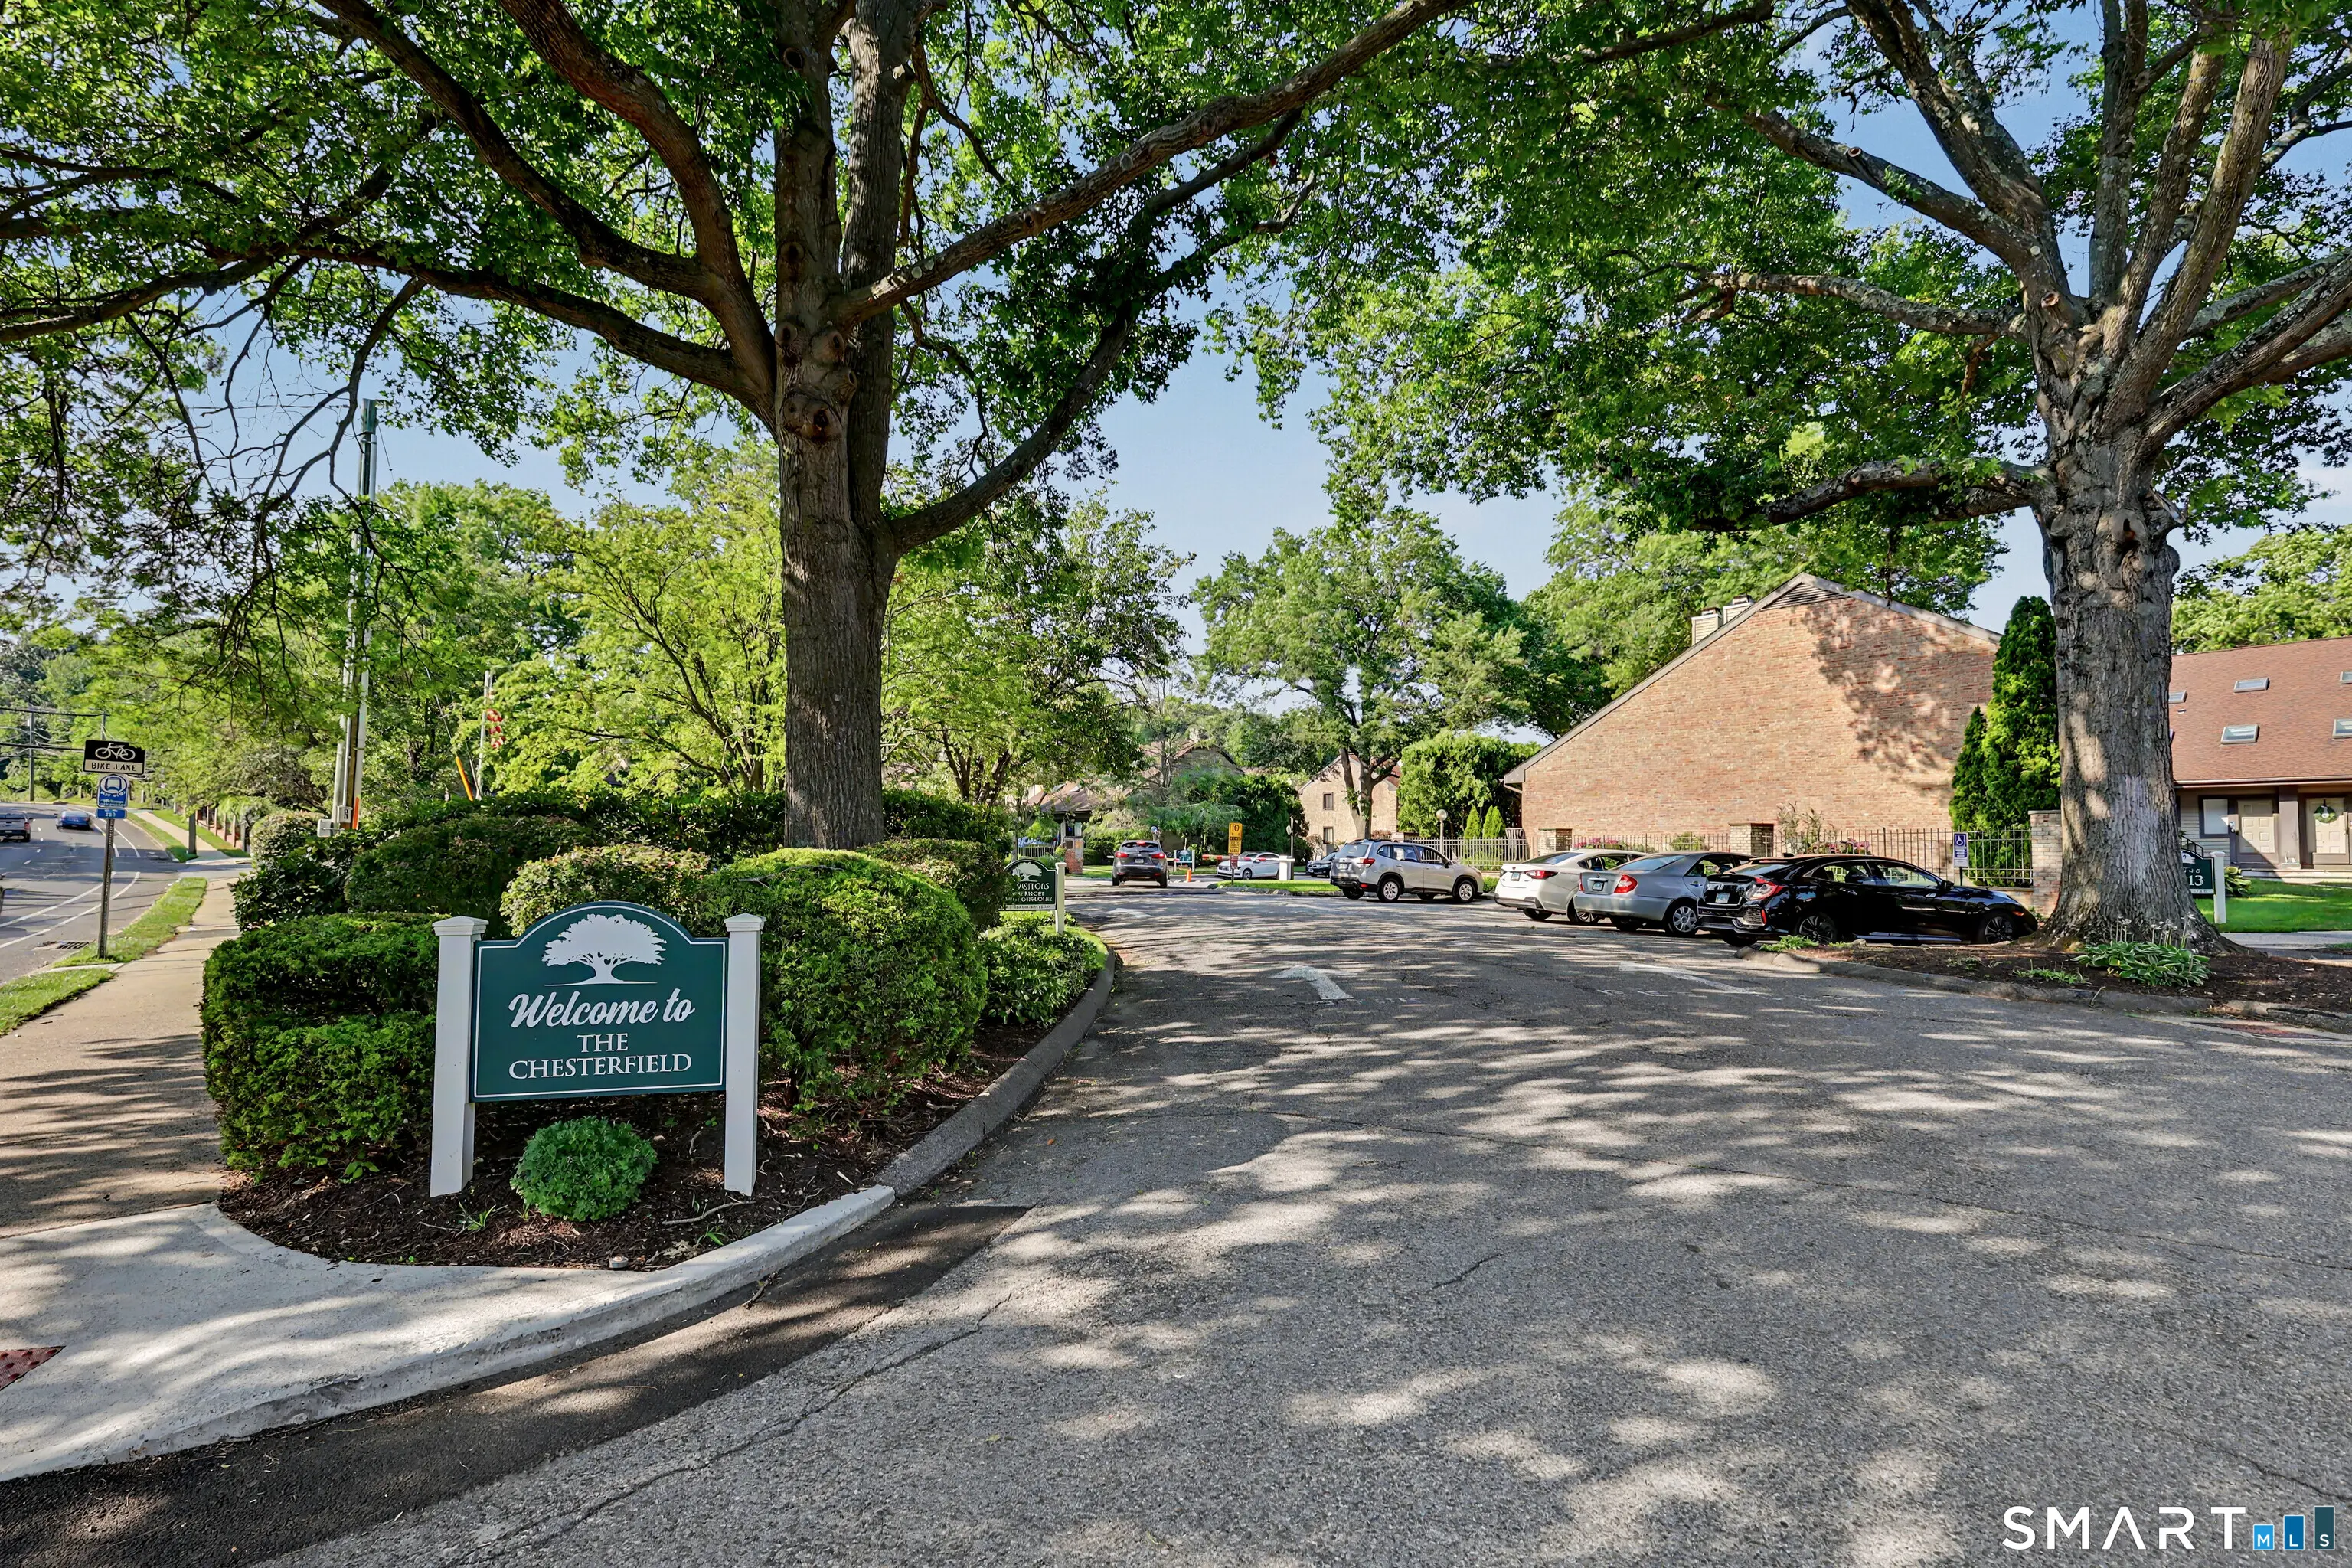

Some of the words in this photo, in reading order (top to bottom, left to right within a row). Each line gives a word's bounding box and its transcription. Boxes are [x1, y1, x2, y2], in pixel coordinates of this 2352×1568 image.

[508, 991, 658, 1027] Welcome
[662, 988, 696, 1022] to
[577, 1033, 629, 1053] THE
[508, 1053, 692, 1080] CHESTERFIELD
